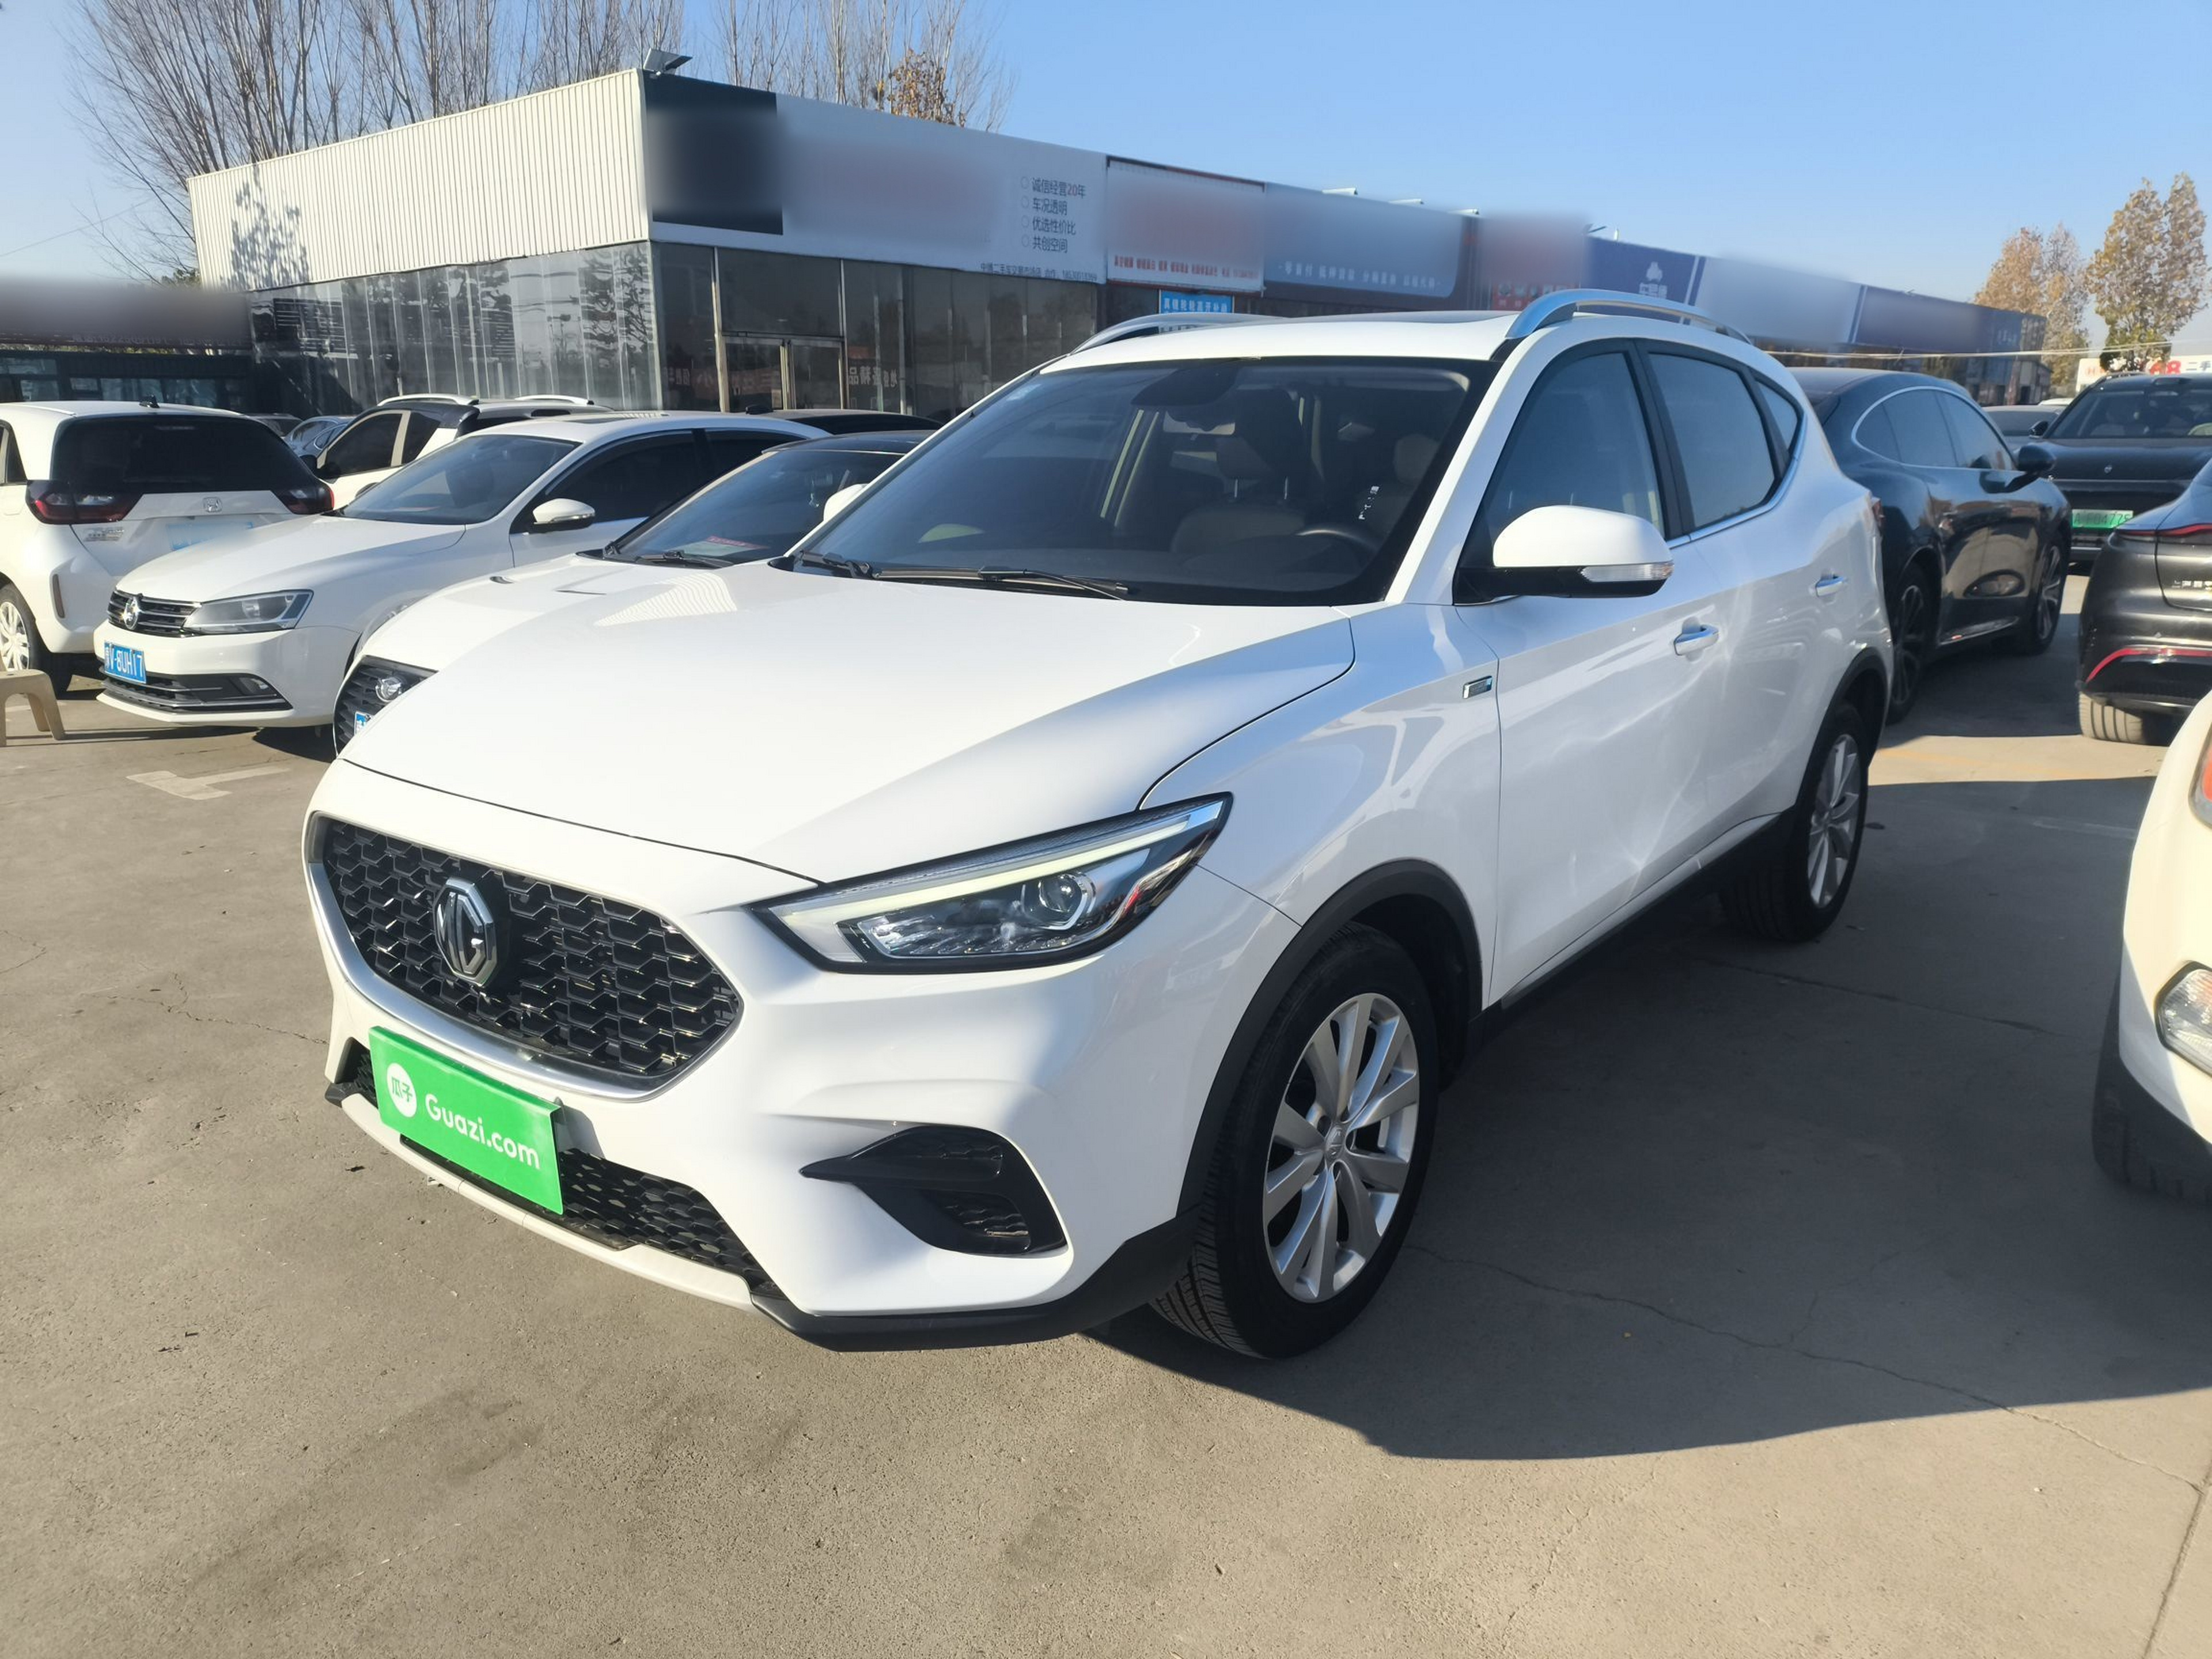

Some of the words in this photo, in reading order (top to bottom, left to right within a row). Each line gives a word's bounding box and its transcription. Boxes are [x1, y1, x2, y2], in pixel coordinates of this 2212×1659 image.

[1032, 177, 1085, 199] 诚信经营20年
[1032, 198, 1067, 216] 车况透明
[1032, 217, 1075, 235] 优选性价比
[1032, 236, 1067, 253] 共创空间
[391, 1076, 413, 1103] 瓜子
[425, 1093, 540, 1169] Guazi.com
